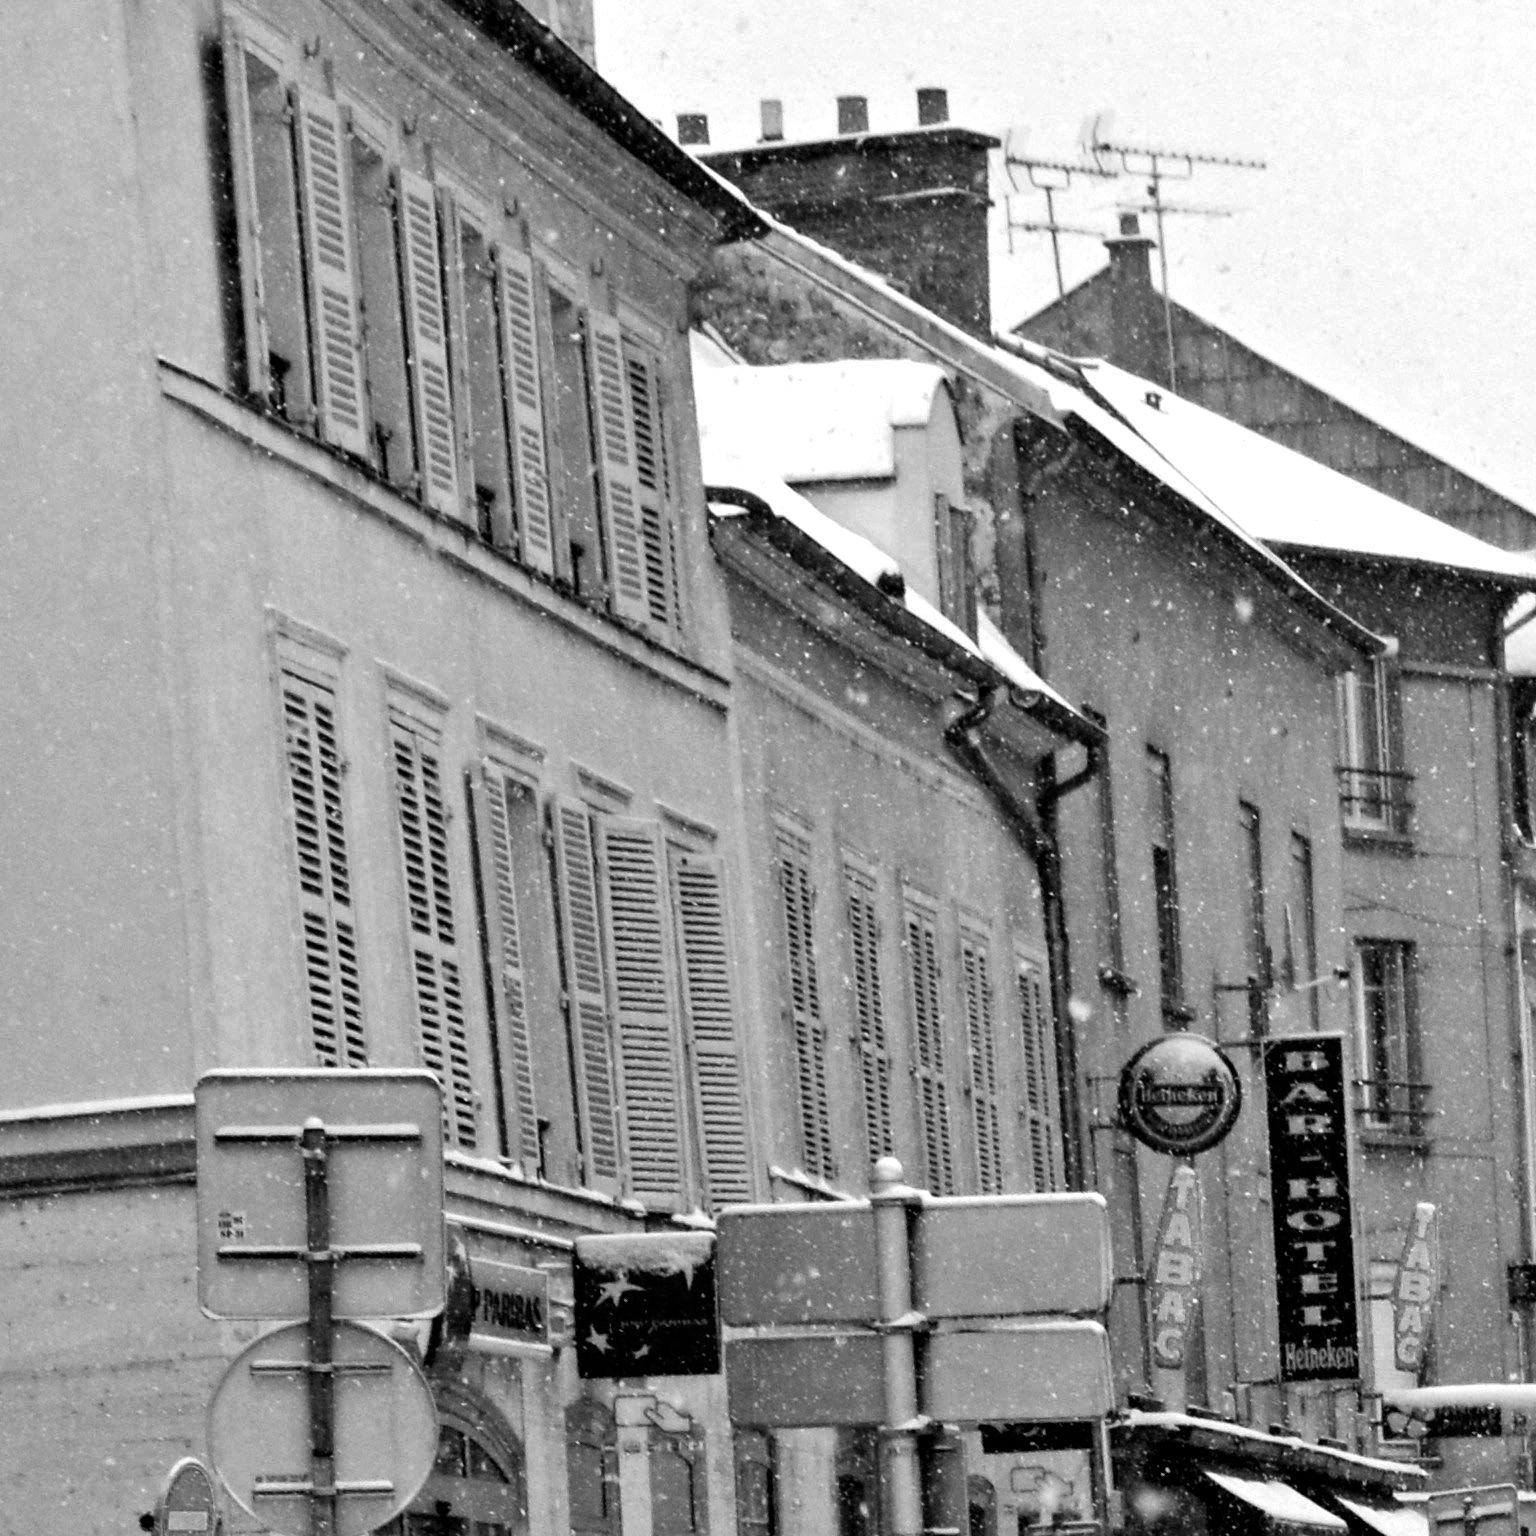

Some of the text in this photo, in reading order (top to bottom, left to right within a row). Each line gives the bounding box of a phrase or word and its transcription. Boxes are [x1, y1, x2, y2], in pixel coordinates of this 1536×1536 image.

[1155, 1177, 1196, 1360] TABAC
[1397, 1207, 1431, 1363] TABAC
[1285, 1341, 1355, 1371] Heineken
